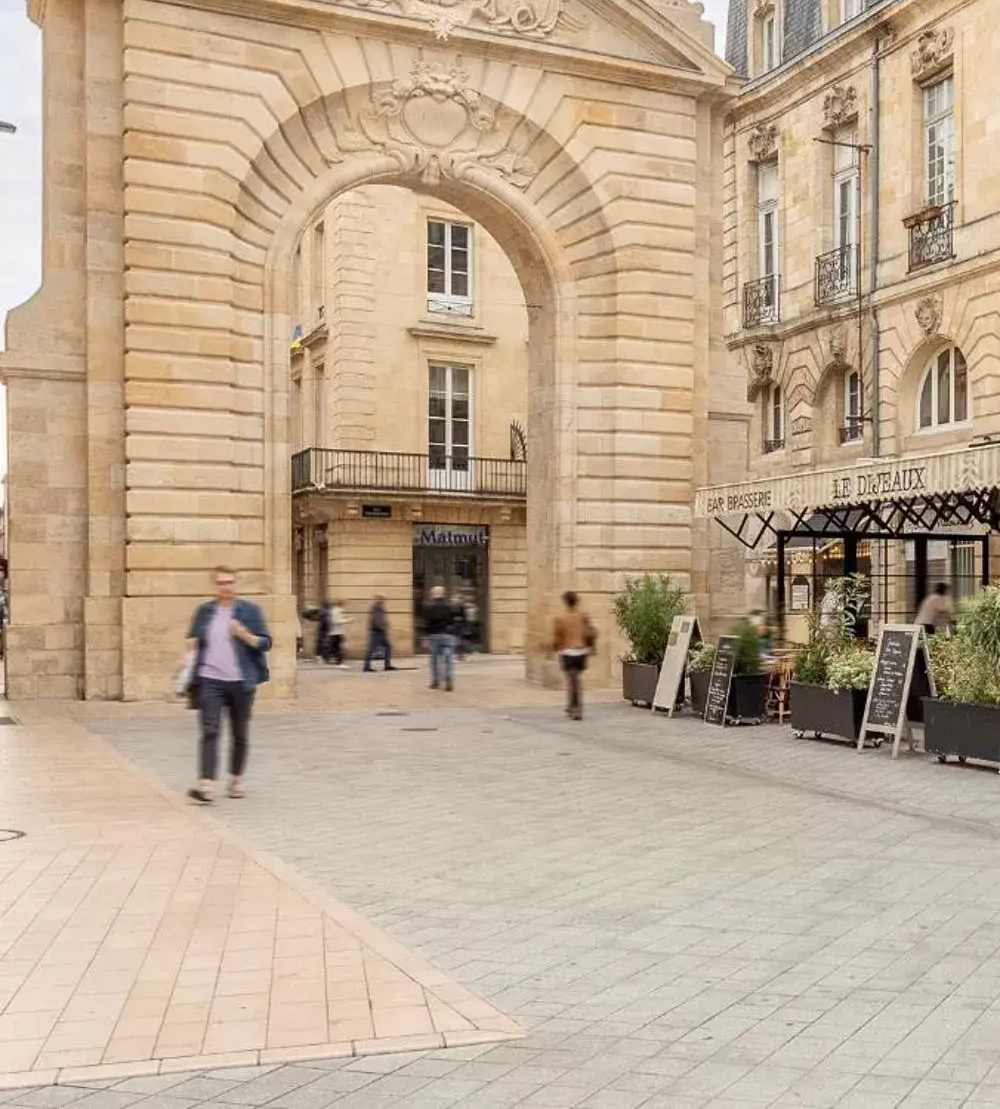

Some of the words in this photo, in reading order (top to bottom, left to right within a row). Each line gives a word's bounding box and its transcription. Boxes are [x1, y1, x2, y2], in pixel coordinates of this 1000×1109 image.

[832, 478, 851, 499] LE
[857, 467, 926, 496] DIJEAUX
[706, 497, 724, 513] BAR
[727, 490, 772, 511] BRASSERIE
[420, 529, 487, 545] Matmut
